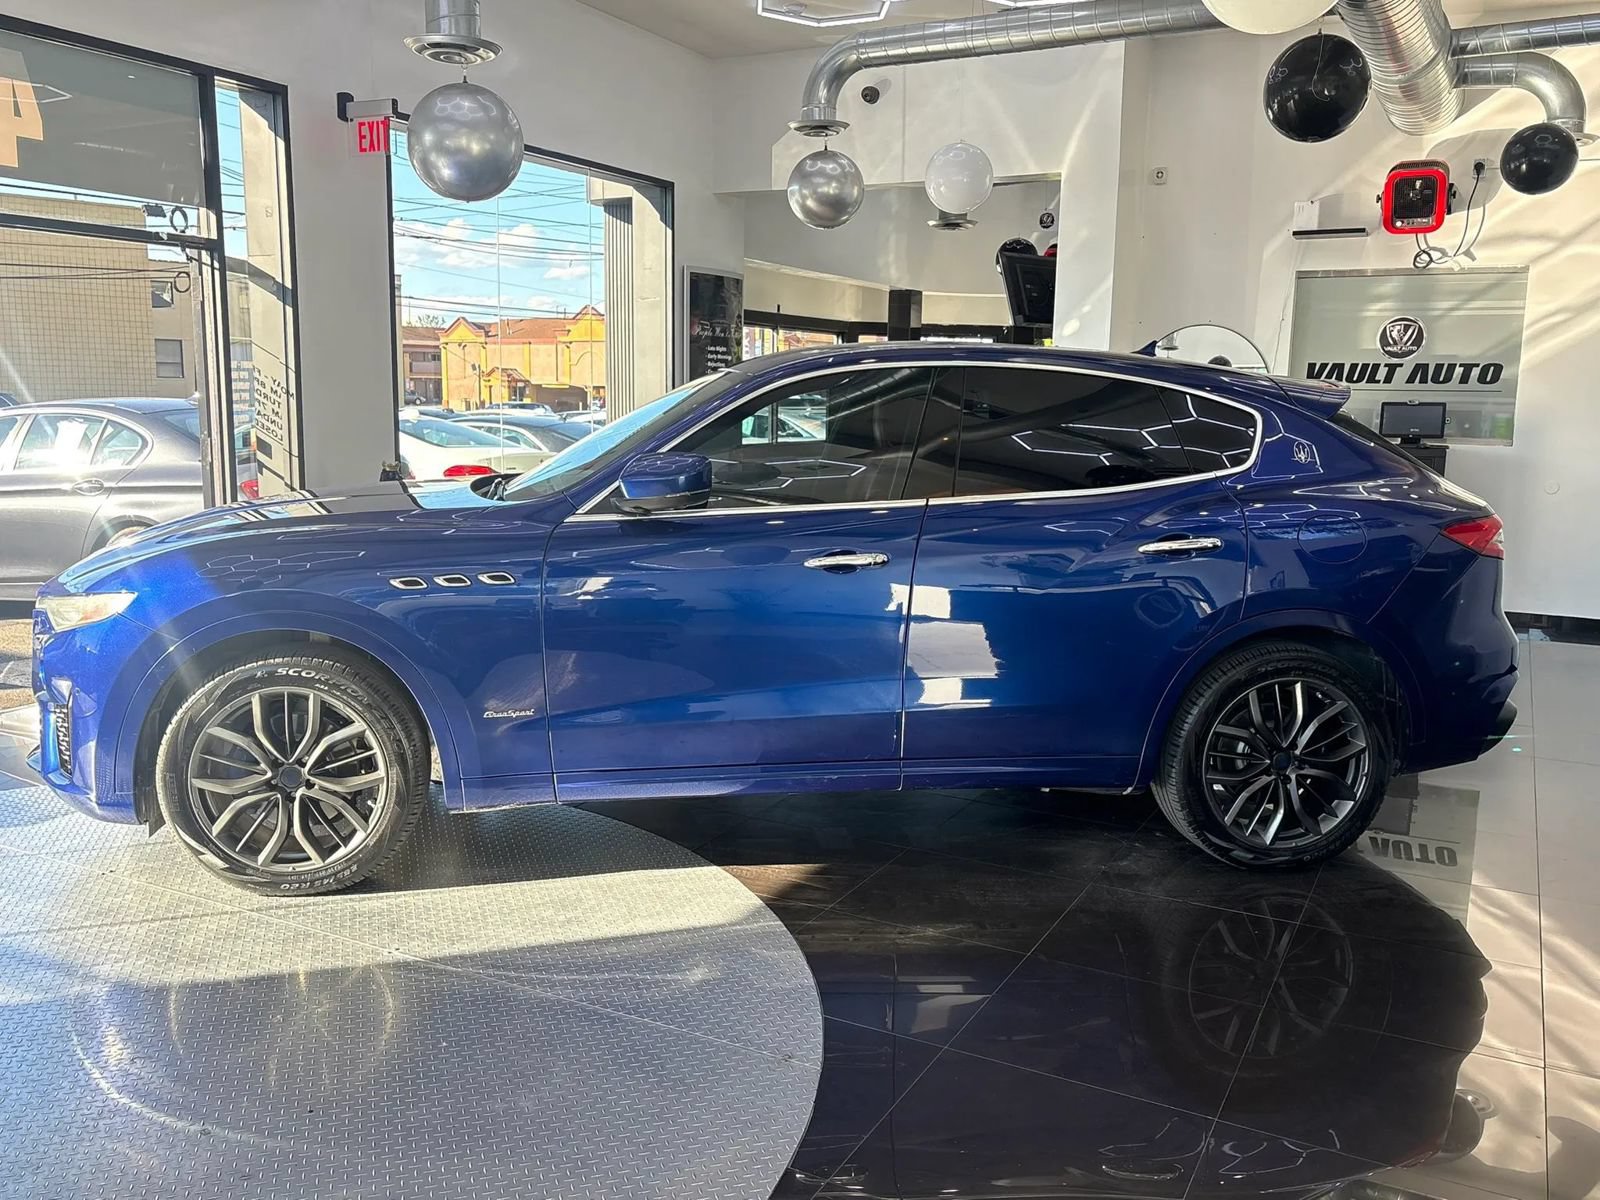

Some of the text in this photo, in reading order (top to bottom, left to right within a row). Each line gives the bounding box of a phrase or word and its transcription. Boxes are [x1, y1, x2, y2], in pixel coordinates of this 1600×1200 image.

[357, 119, 388, 153] EXIT
[1306, 362, 1504, 385] VAULT AUTO
[275, 667, 369, 706] SCORPION
